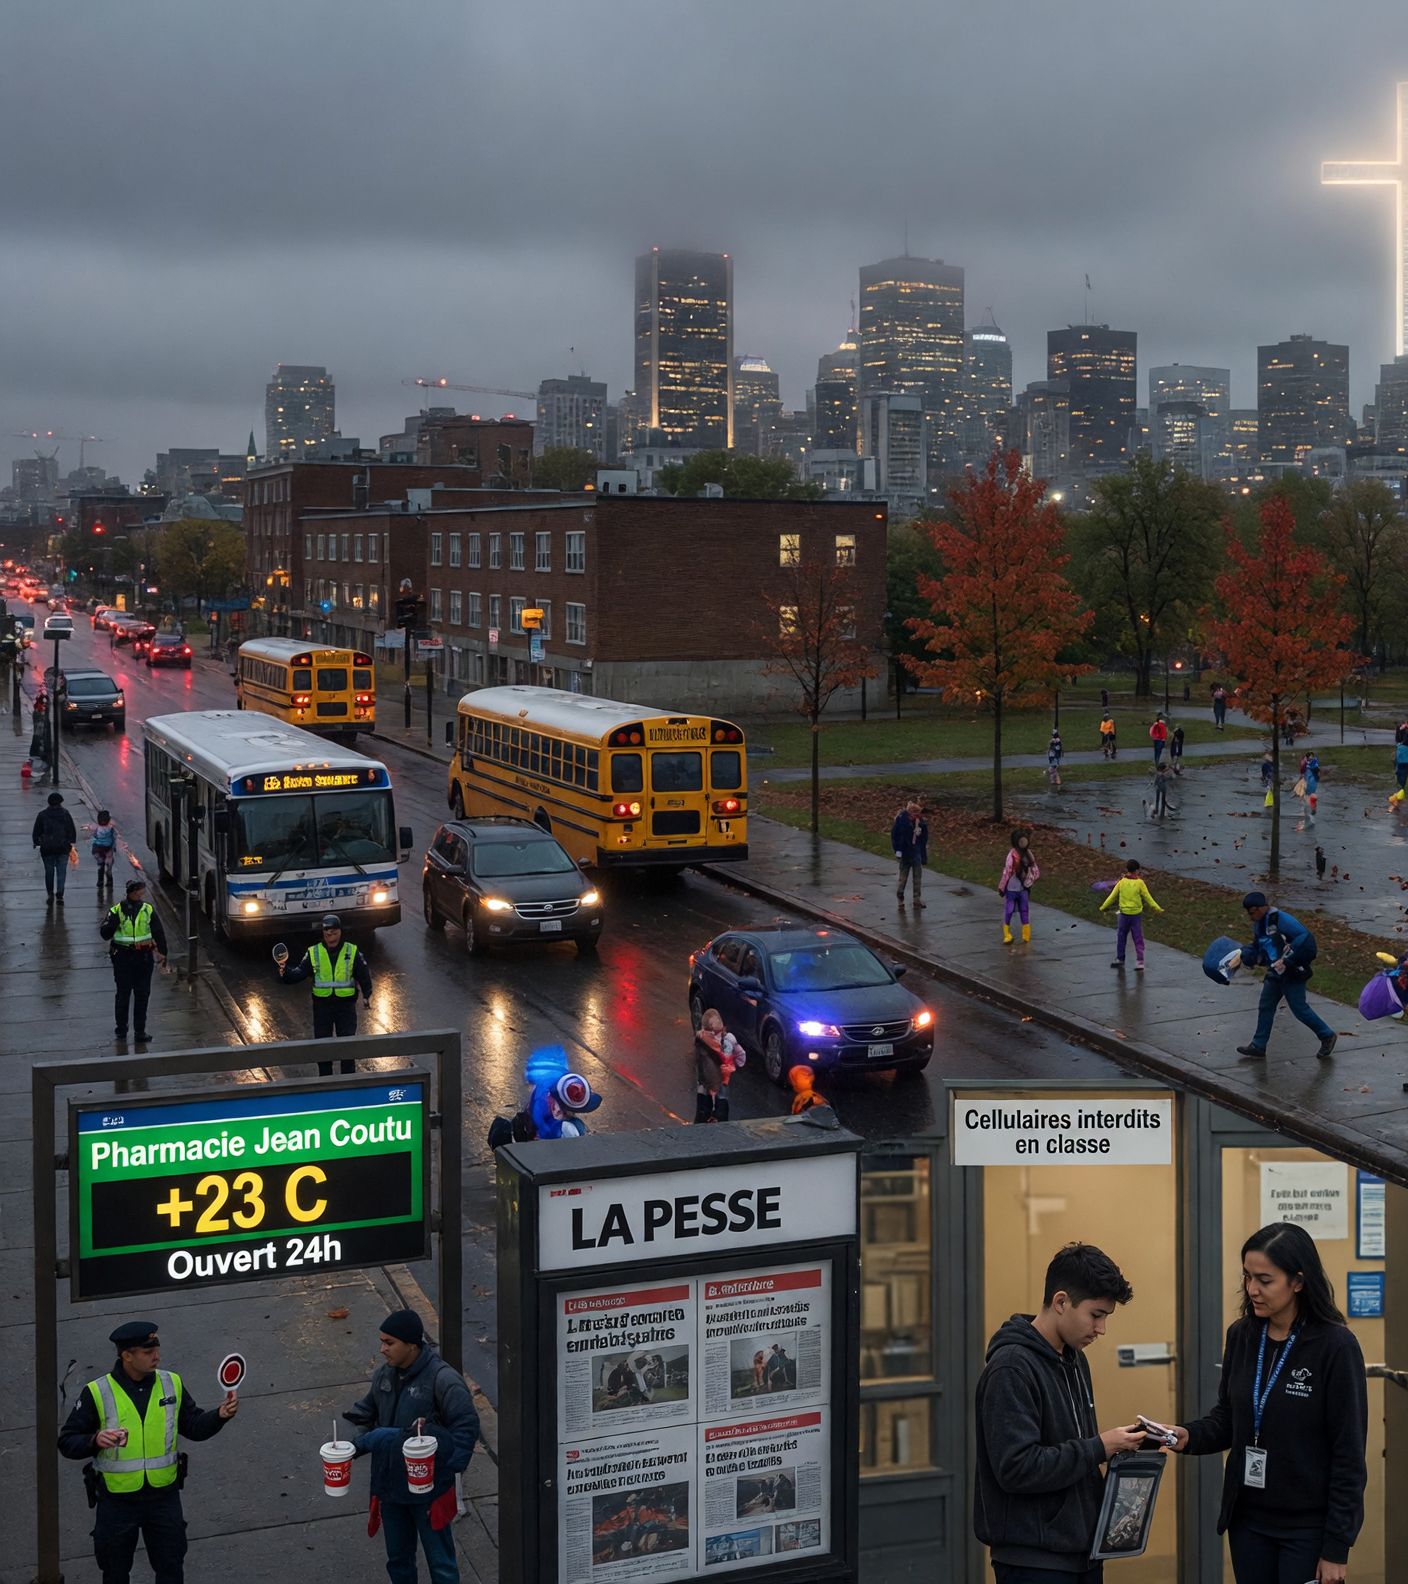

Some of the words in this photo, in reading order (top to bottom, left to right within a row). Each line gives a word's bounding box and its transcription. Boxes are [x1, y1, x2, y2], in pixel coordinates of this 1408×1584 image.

[91, 1131, 246, 1170] Pharmacie
[254, 1127, 320, 1155] Jean
[329, 1115, 412, 1146] Coutu
[965, 1109, 1071, 1130] Cellulaires
[1078, 1109, 1161, 1129] interdits
[1015, 1138, 1039, 1154] en
[1046, 1134, 1111, 1154] classe
[156, 1171, 266, 1234] +23
[284, 1165, 328, 1223] C
[571, 1202, 635, 1250] LA
[643, 1187, 782, 1242] PESSE
[167, 1242, 277, 1280] Ouvert
[286, 1234, 341, 1266] 24h
